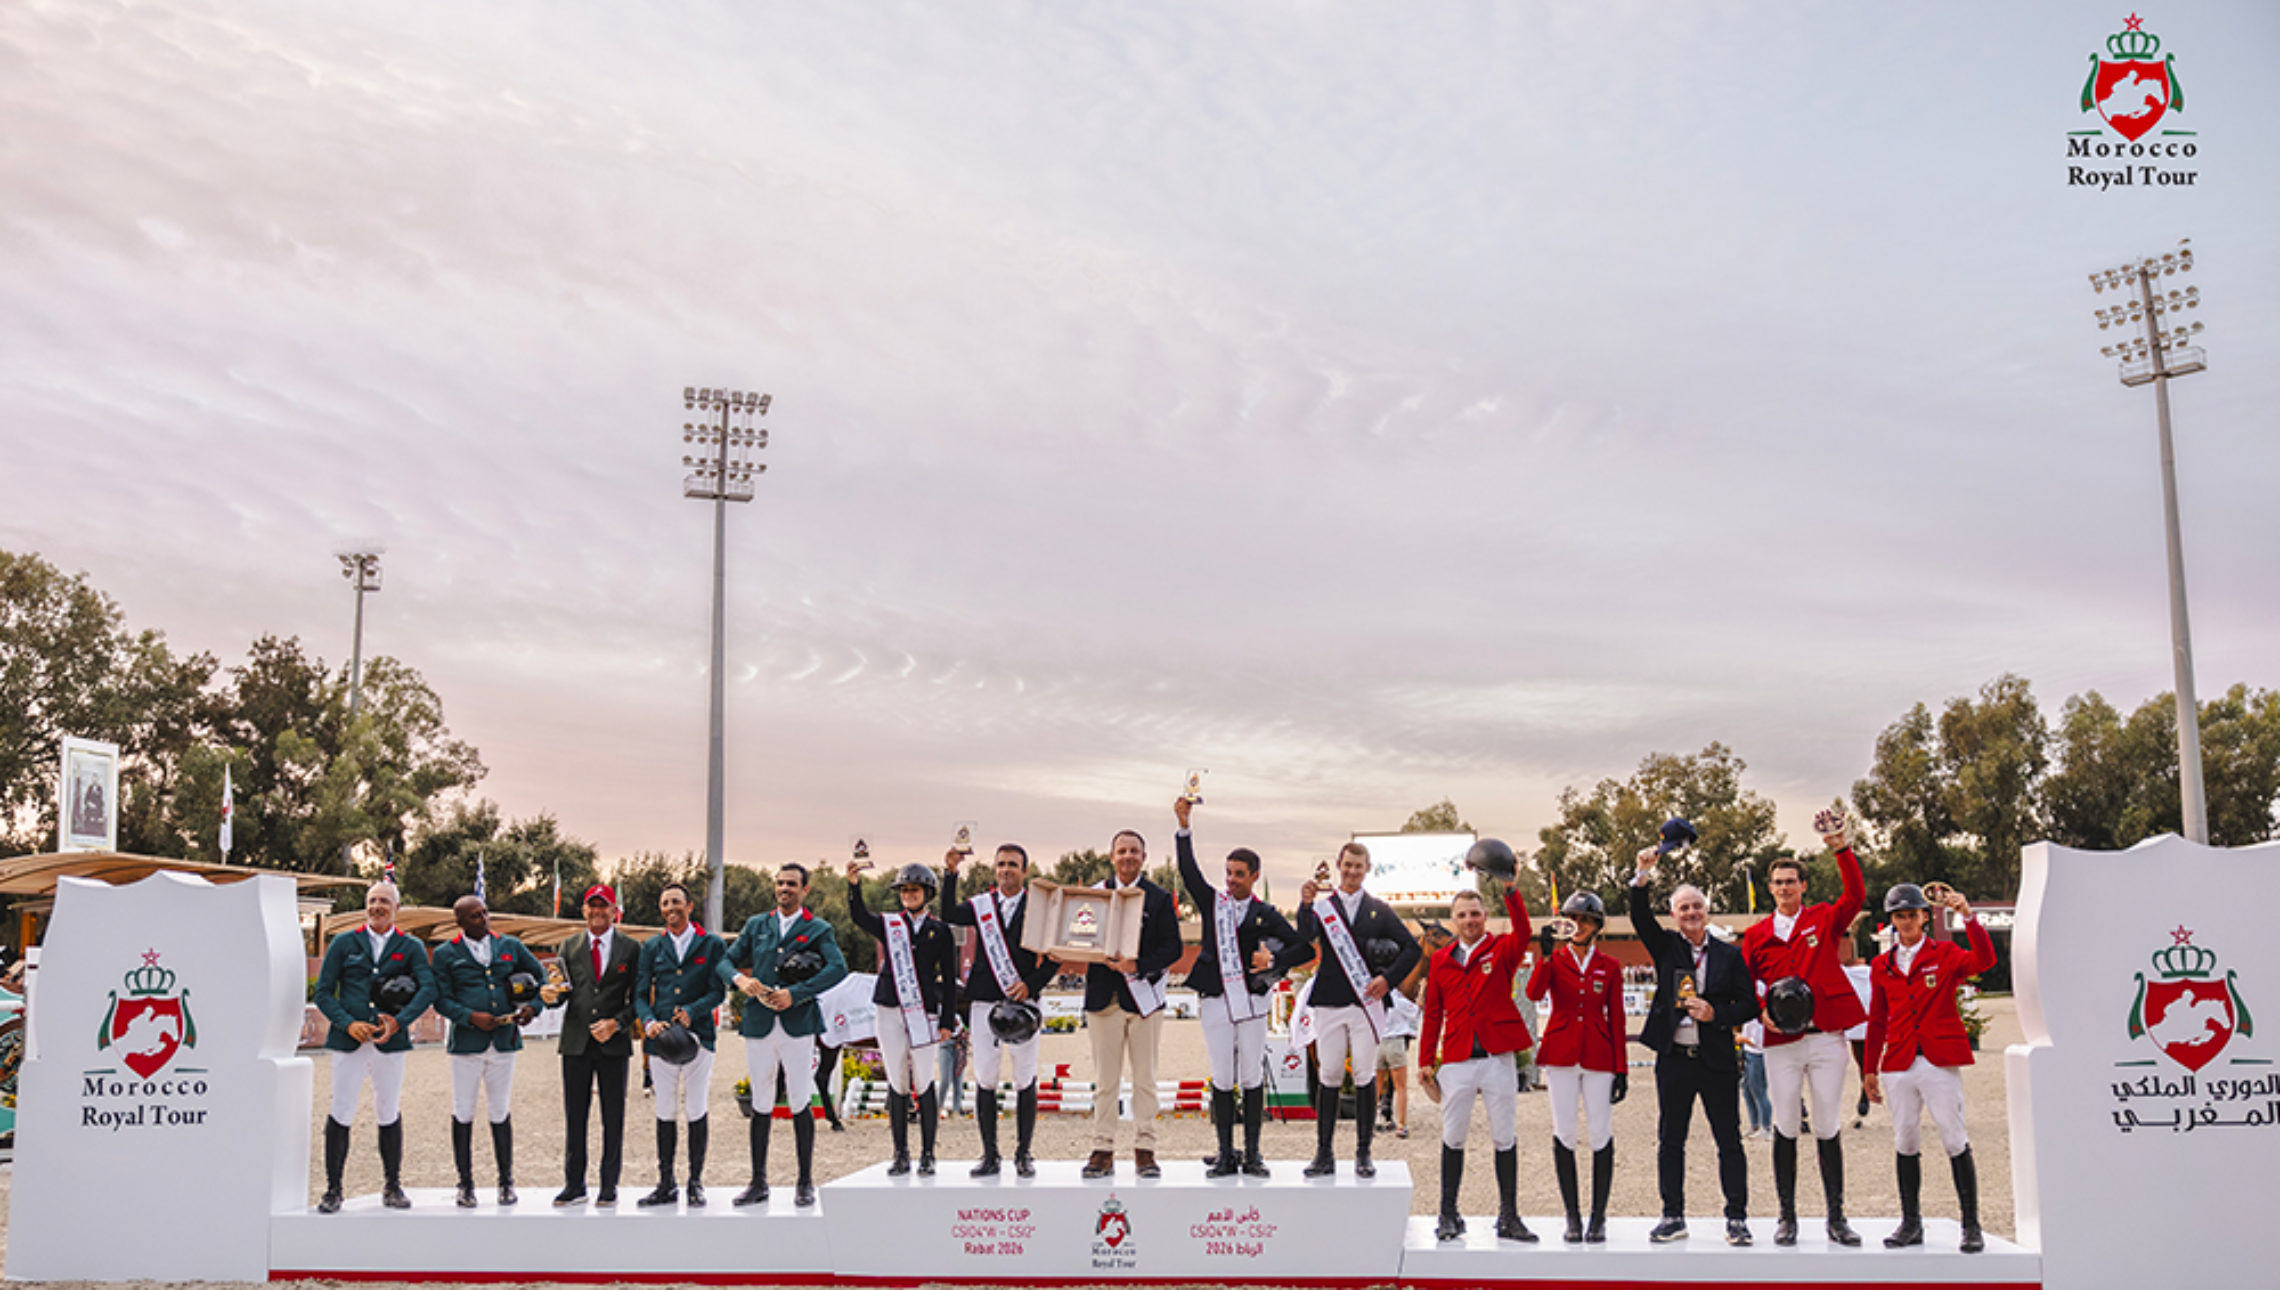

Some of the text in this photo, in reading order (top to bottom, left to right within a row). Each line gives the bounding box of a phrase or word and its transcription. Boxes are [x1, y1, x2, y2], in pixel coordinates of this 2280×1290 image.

[82, 1077, 208, 1097] Morocco
[2111, 1074, 2280, 1102] الدوري الملكي
[82, 1104, 208, 1132] Royal Tour
[2112, 1101, 2280, 1133] المغربي
[957, 1208, 1031, 1222] NATIONS CUP
[964, 1241, 1024, 1255] Rabat 2026
[1206, 1241, 1234, 1255] 2026
